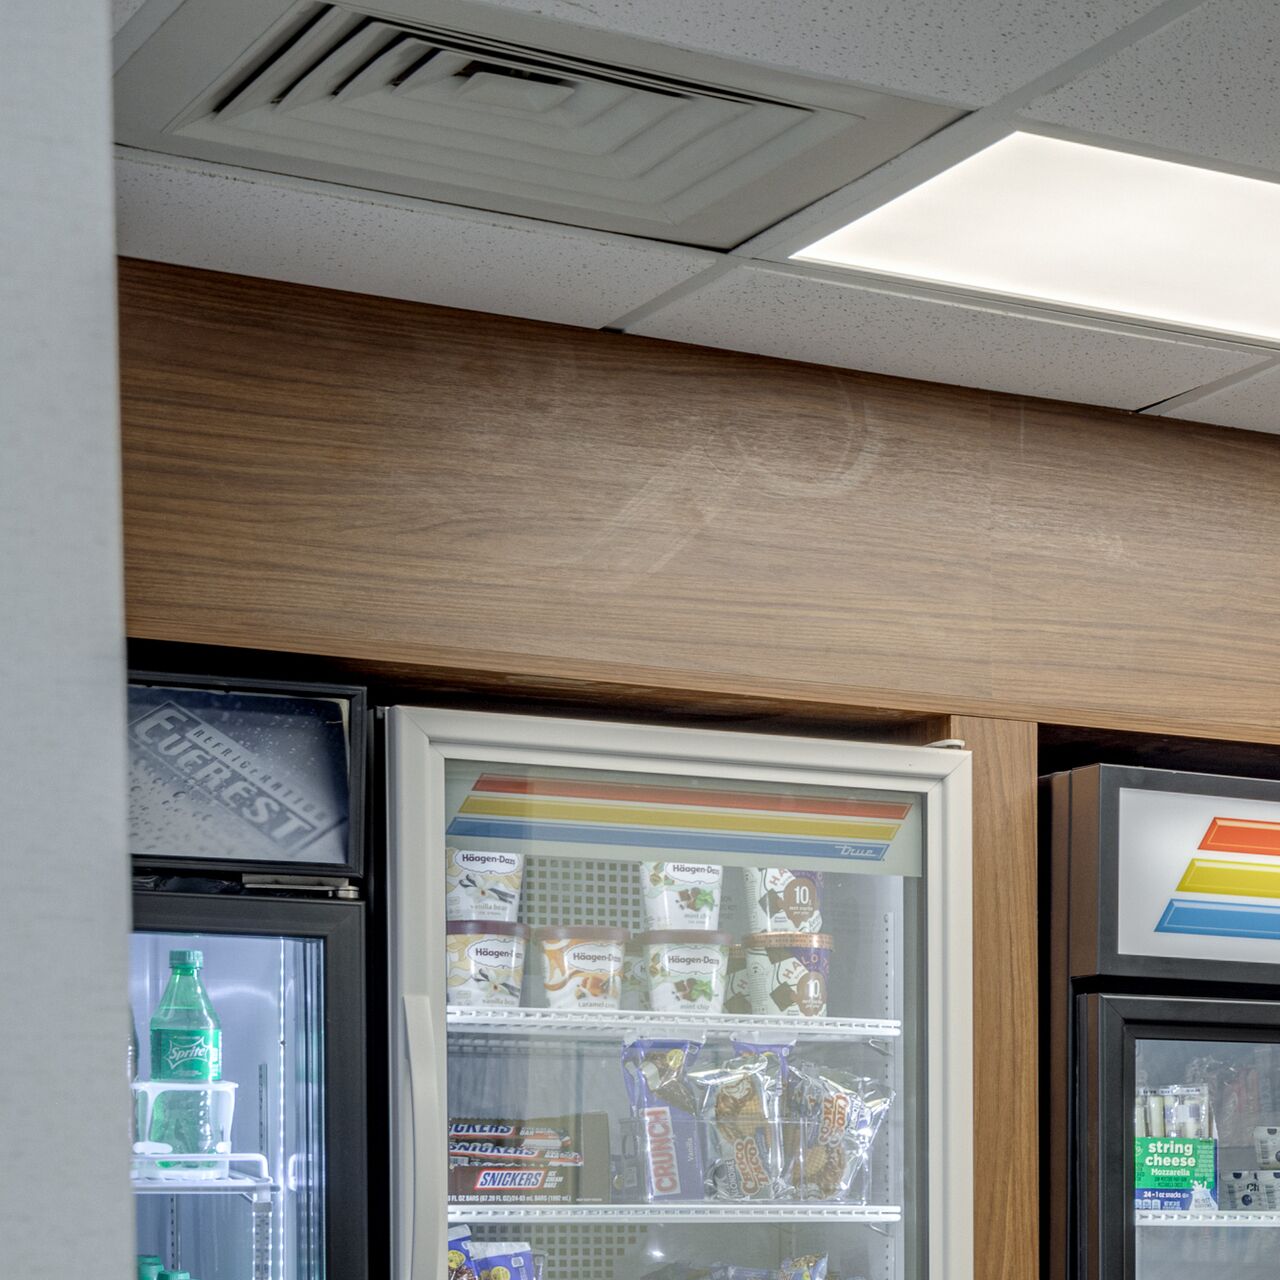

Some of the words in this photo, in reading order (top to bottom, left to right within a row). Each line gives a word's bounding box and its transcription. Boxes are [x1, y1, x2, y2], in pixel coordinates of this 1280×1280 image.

[462, 854, 516, 866] Häagen-Dazs
[168, 1047, 212, 1061] Sprite
[649, 1108, 678, 1193] CRUNCH
[1148, 1140, 1194, 1155] string
[1145, 1155, 1196, 1167] cheese
[480, 1171, 542, 1187] SNICKERS
[1151, 1168, 1190, 1177] Mozzarella
